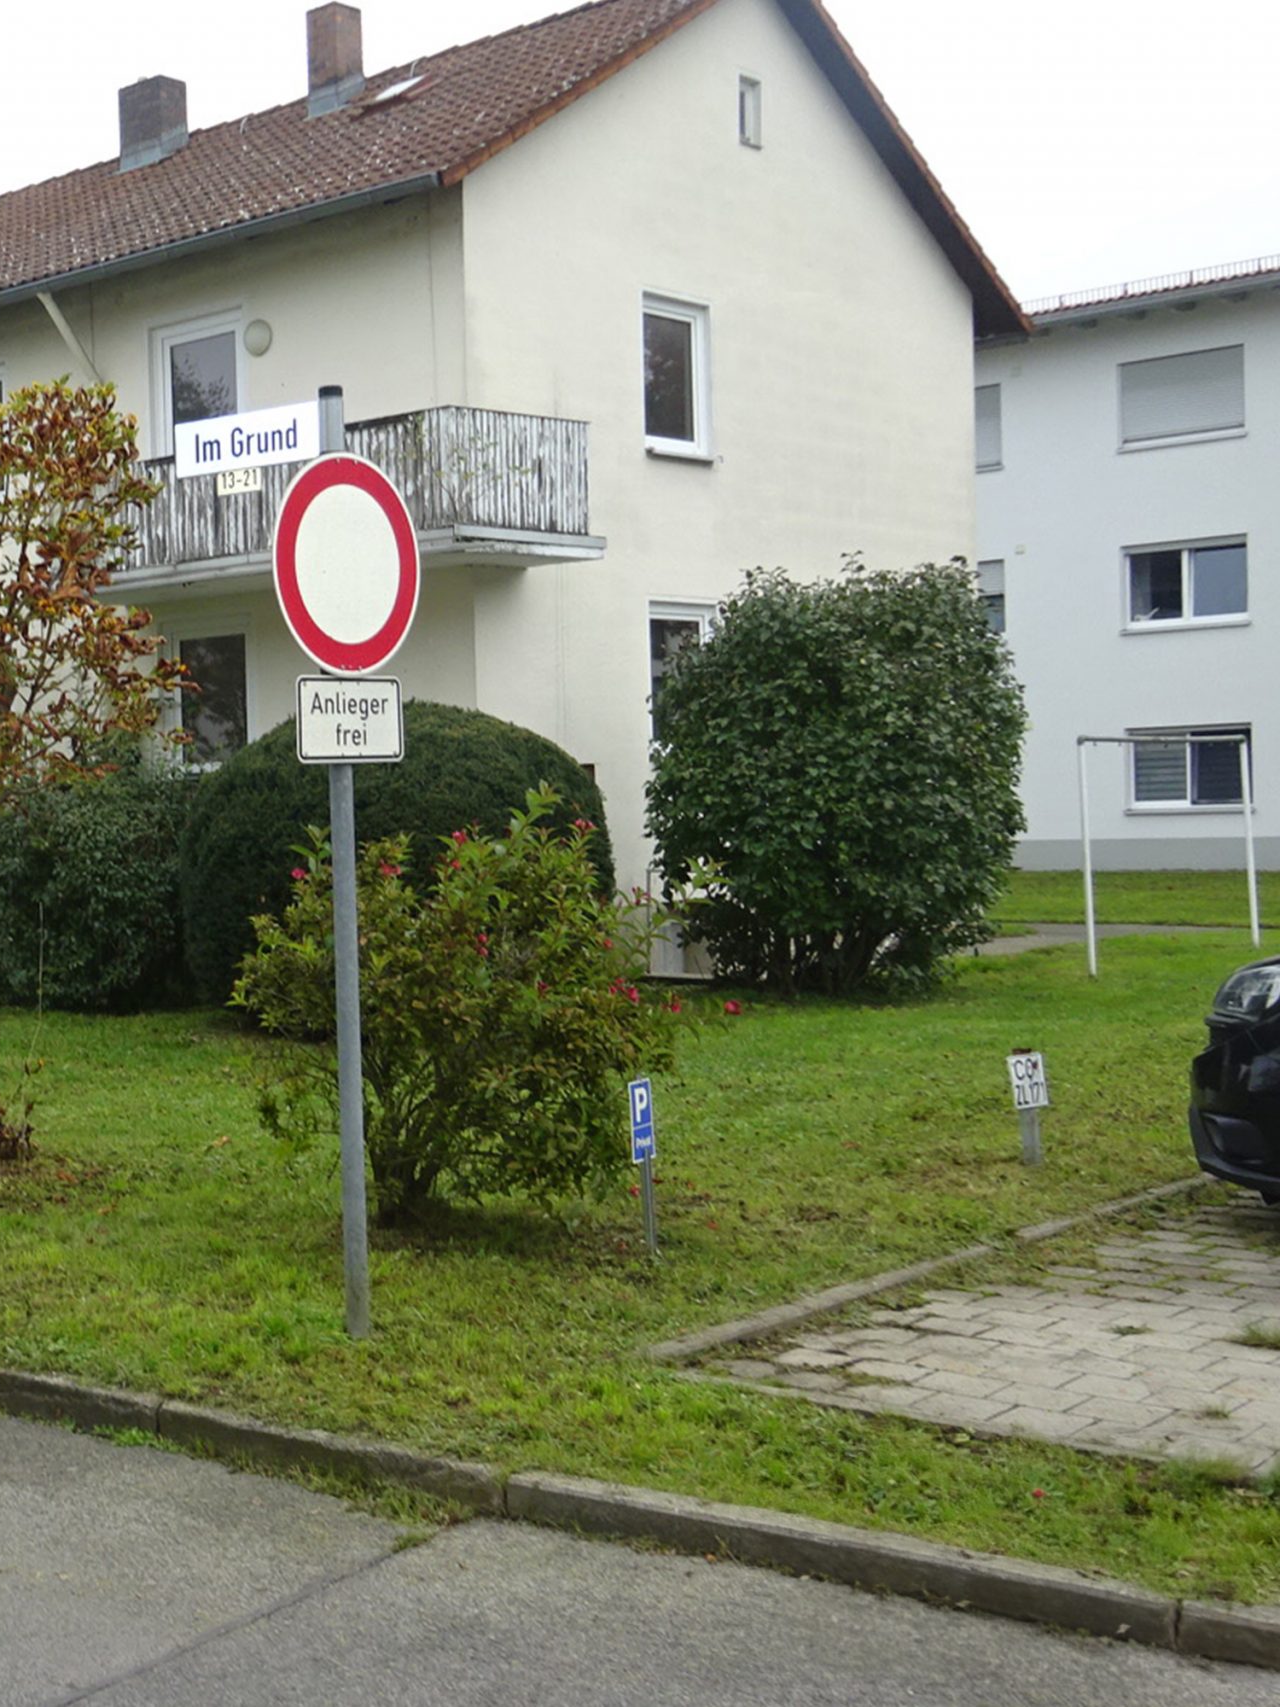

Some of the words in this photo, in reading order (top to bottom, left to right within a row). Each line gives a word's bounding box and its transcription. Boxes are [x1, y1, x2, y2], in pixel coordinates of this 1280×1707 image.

[194, 433, 221, 464] Im
[230, 417, 298, 458] Grund
[222, 468, 257, 490] 13-21
[310, 691, 389, 721] Anlieger
[335, 722, 368, 746] frei
[634, 1086, 648, 1123] P
